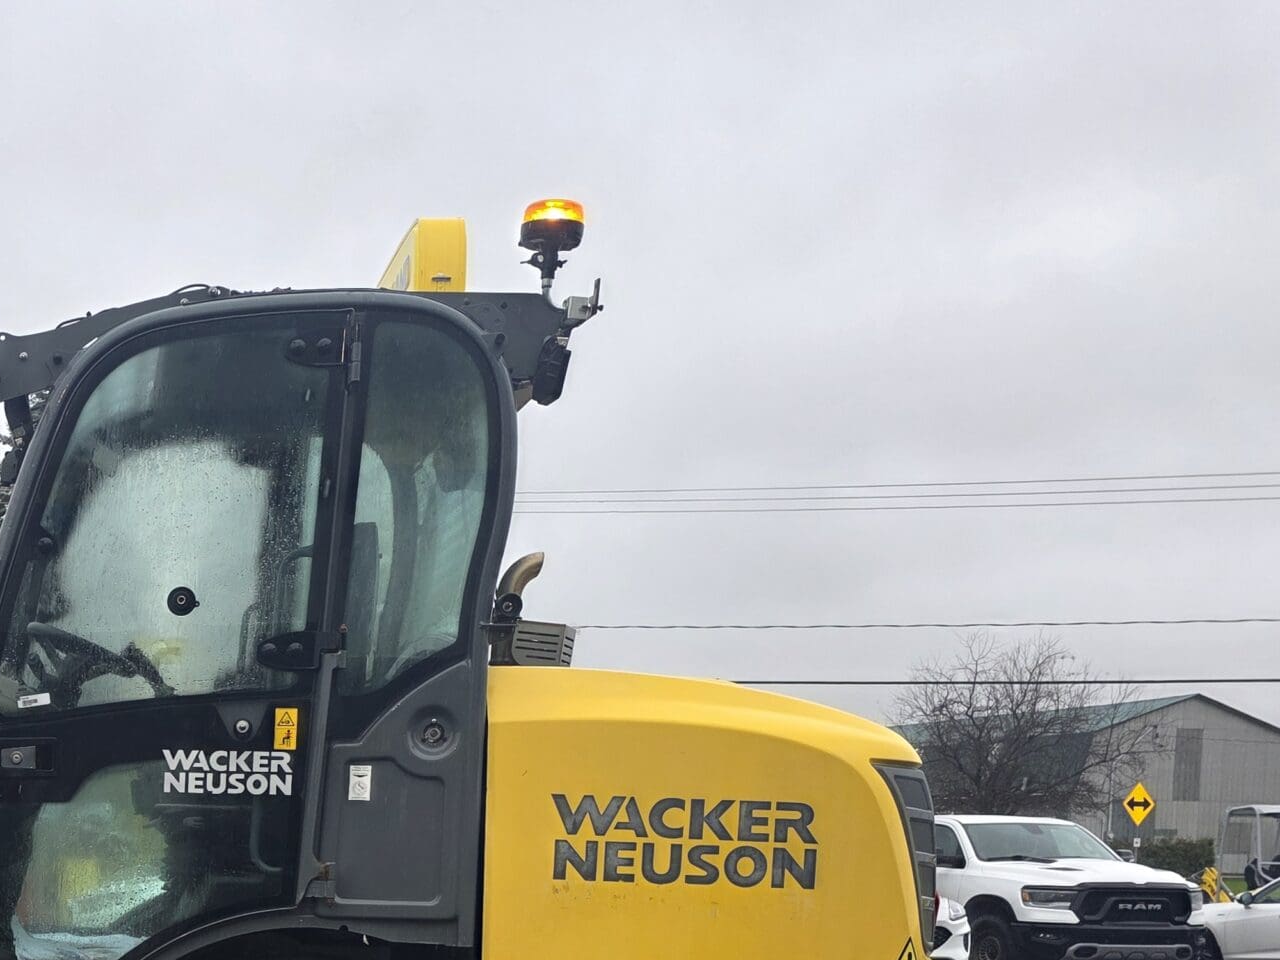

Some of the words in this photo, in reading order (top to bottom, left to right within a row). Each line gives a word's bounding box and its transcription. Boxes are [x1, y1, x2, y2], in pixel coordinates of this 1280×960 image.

[162, 749, 293, 773] WACKER
[163, 772, 293, 796] NEUSON
[551, 793, 818, 844] WACKER
[552, 839, 817, 890] NEUSON
[1118, 903, 1162, 911] RAM
